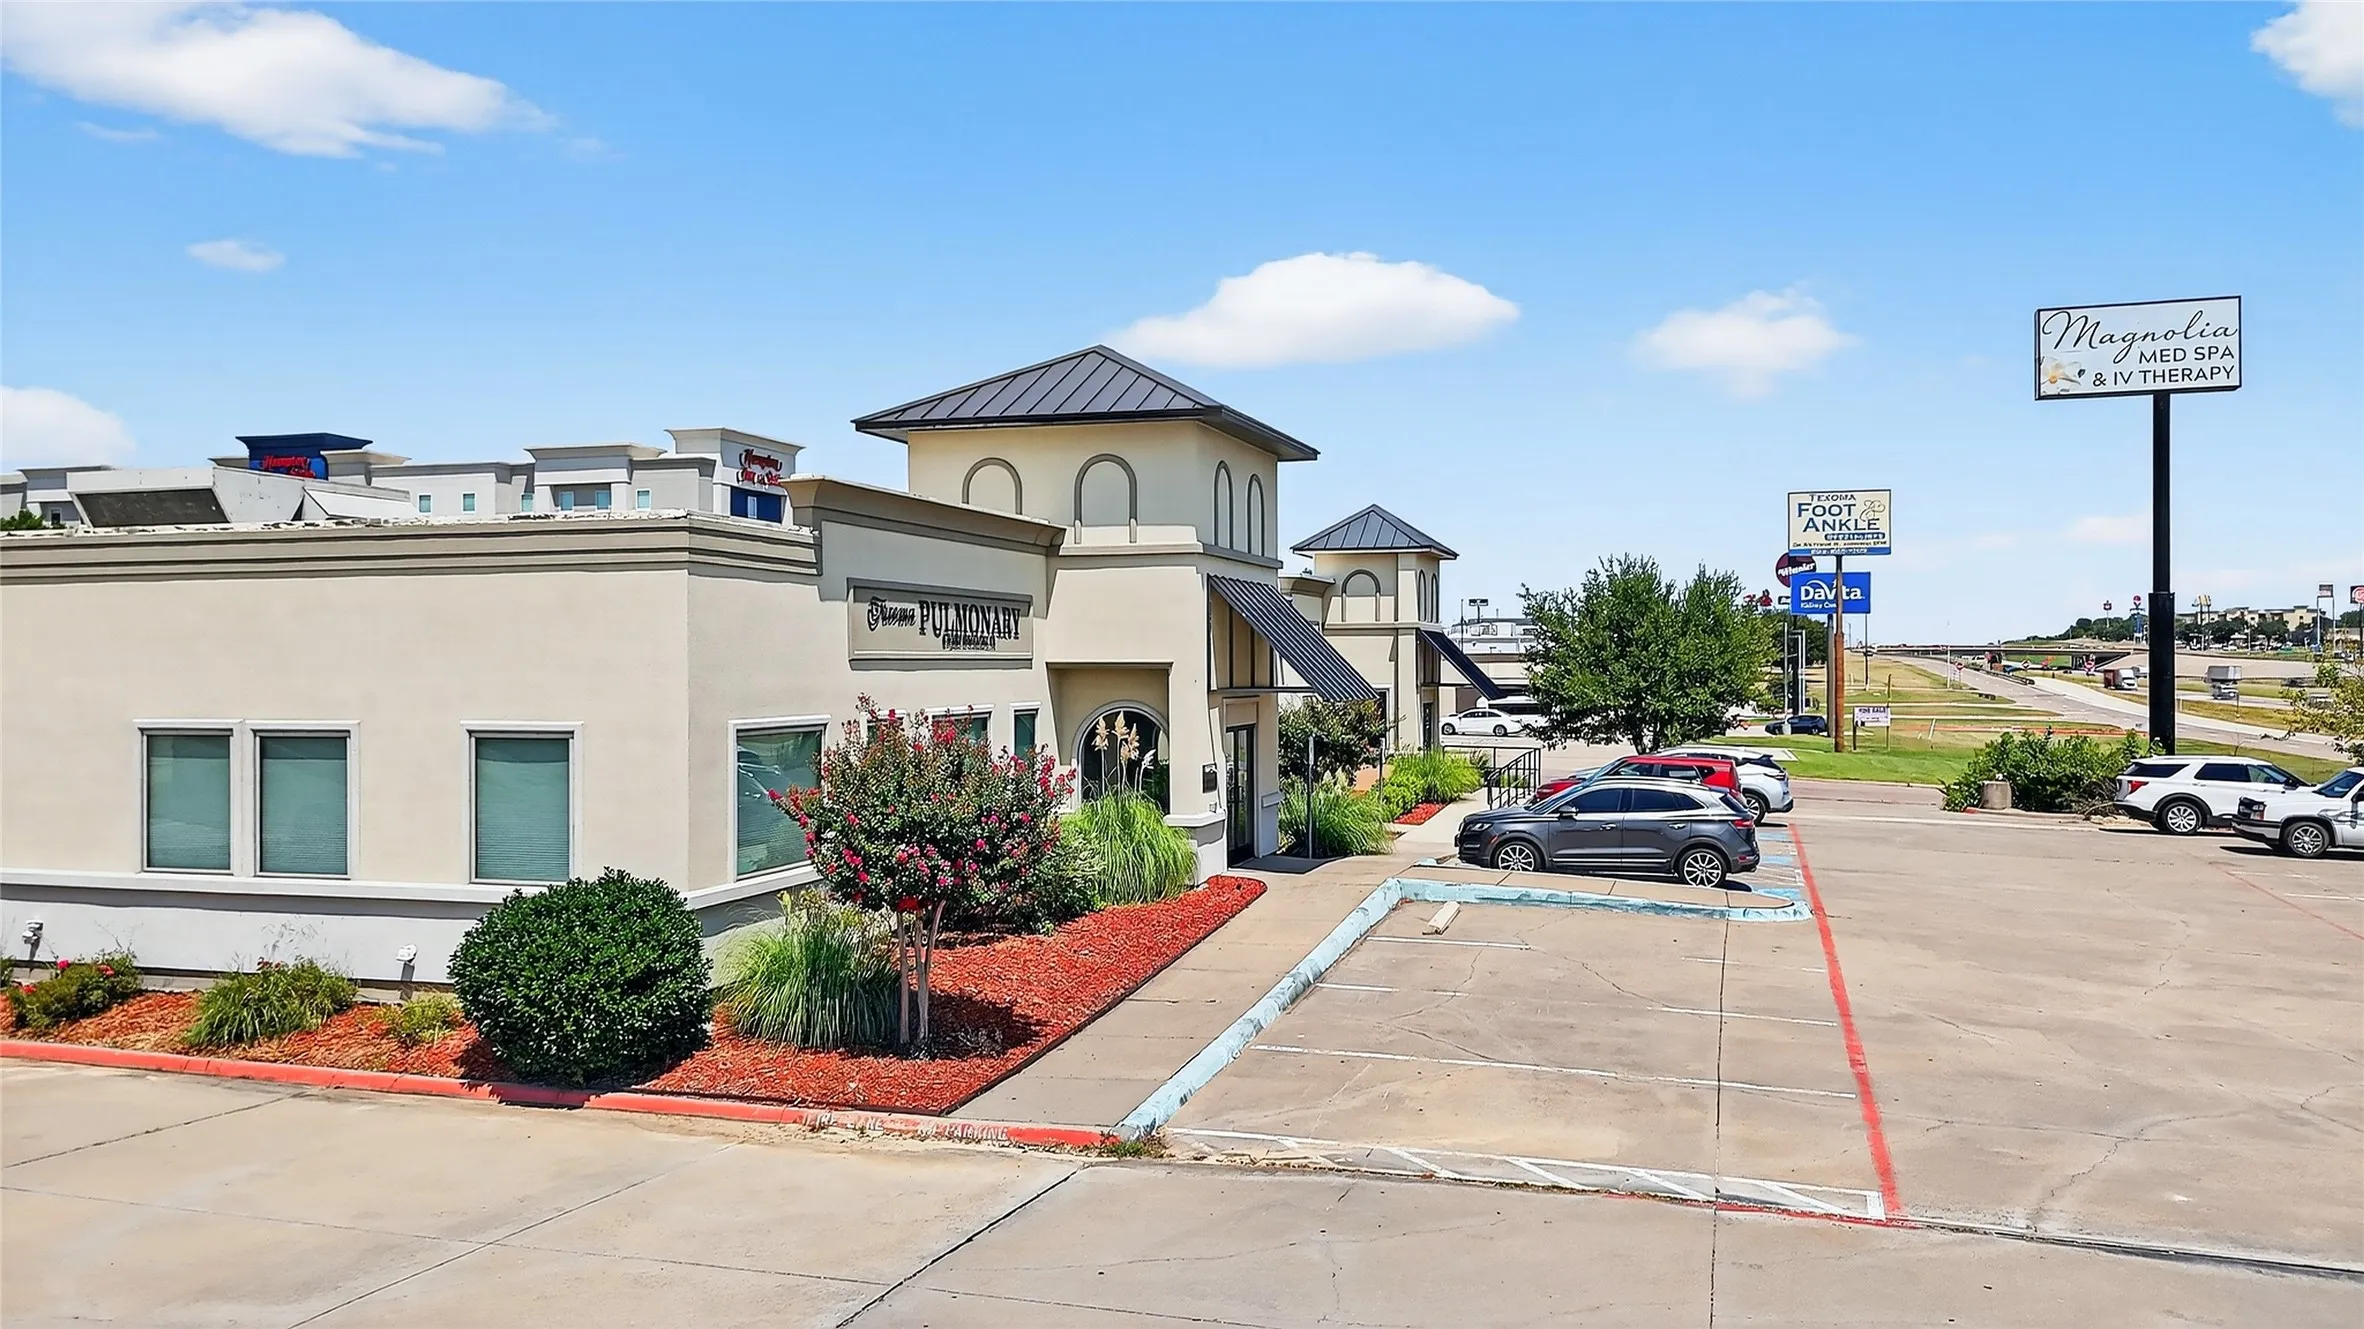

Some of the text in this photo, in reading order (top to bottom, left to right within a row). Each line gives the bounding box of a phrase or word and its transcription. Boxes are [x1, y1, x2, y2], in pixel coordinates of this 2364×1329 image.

[2042, 310, 2238, 364] Magnolia
[2138, 345, 2235, 365] MED SPA
[2092, 365, 2235, 387] & IV THERAPY
[1809, 494, 1857, 502] TEXOMA
[1797, 503, 1857, 517] FOOT
[1803, 517, 1880, 532] ANKLE
[1800, 580, 1862, 600] DaVta
[918, 600, 1020, 639] PULMONARY
